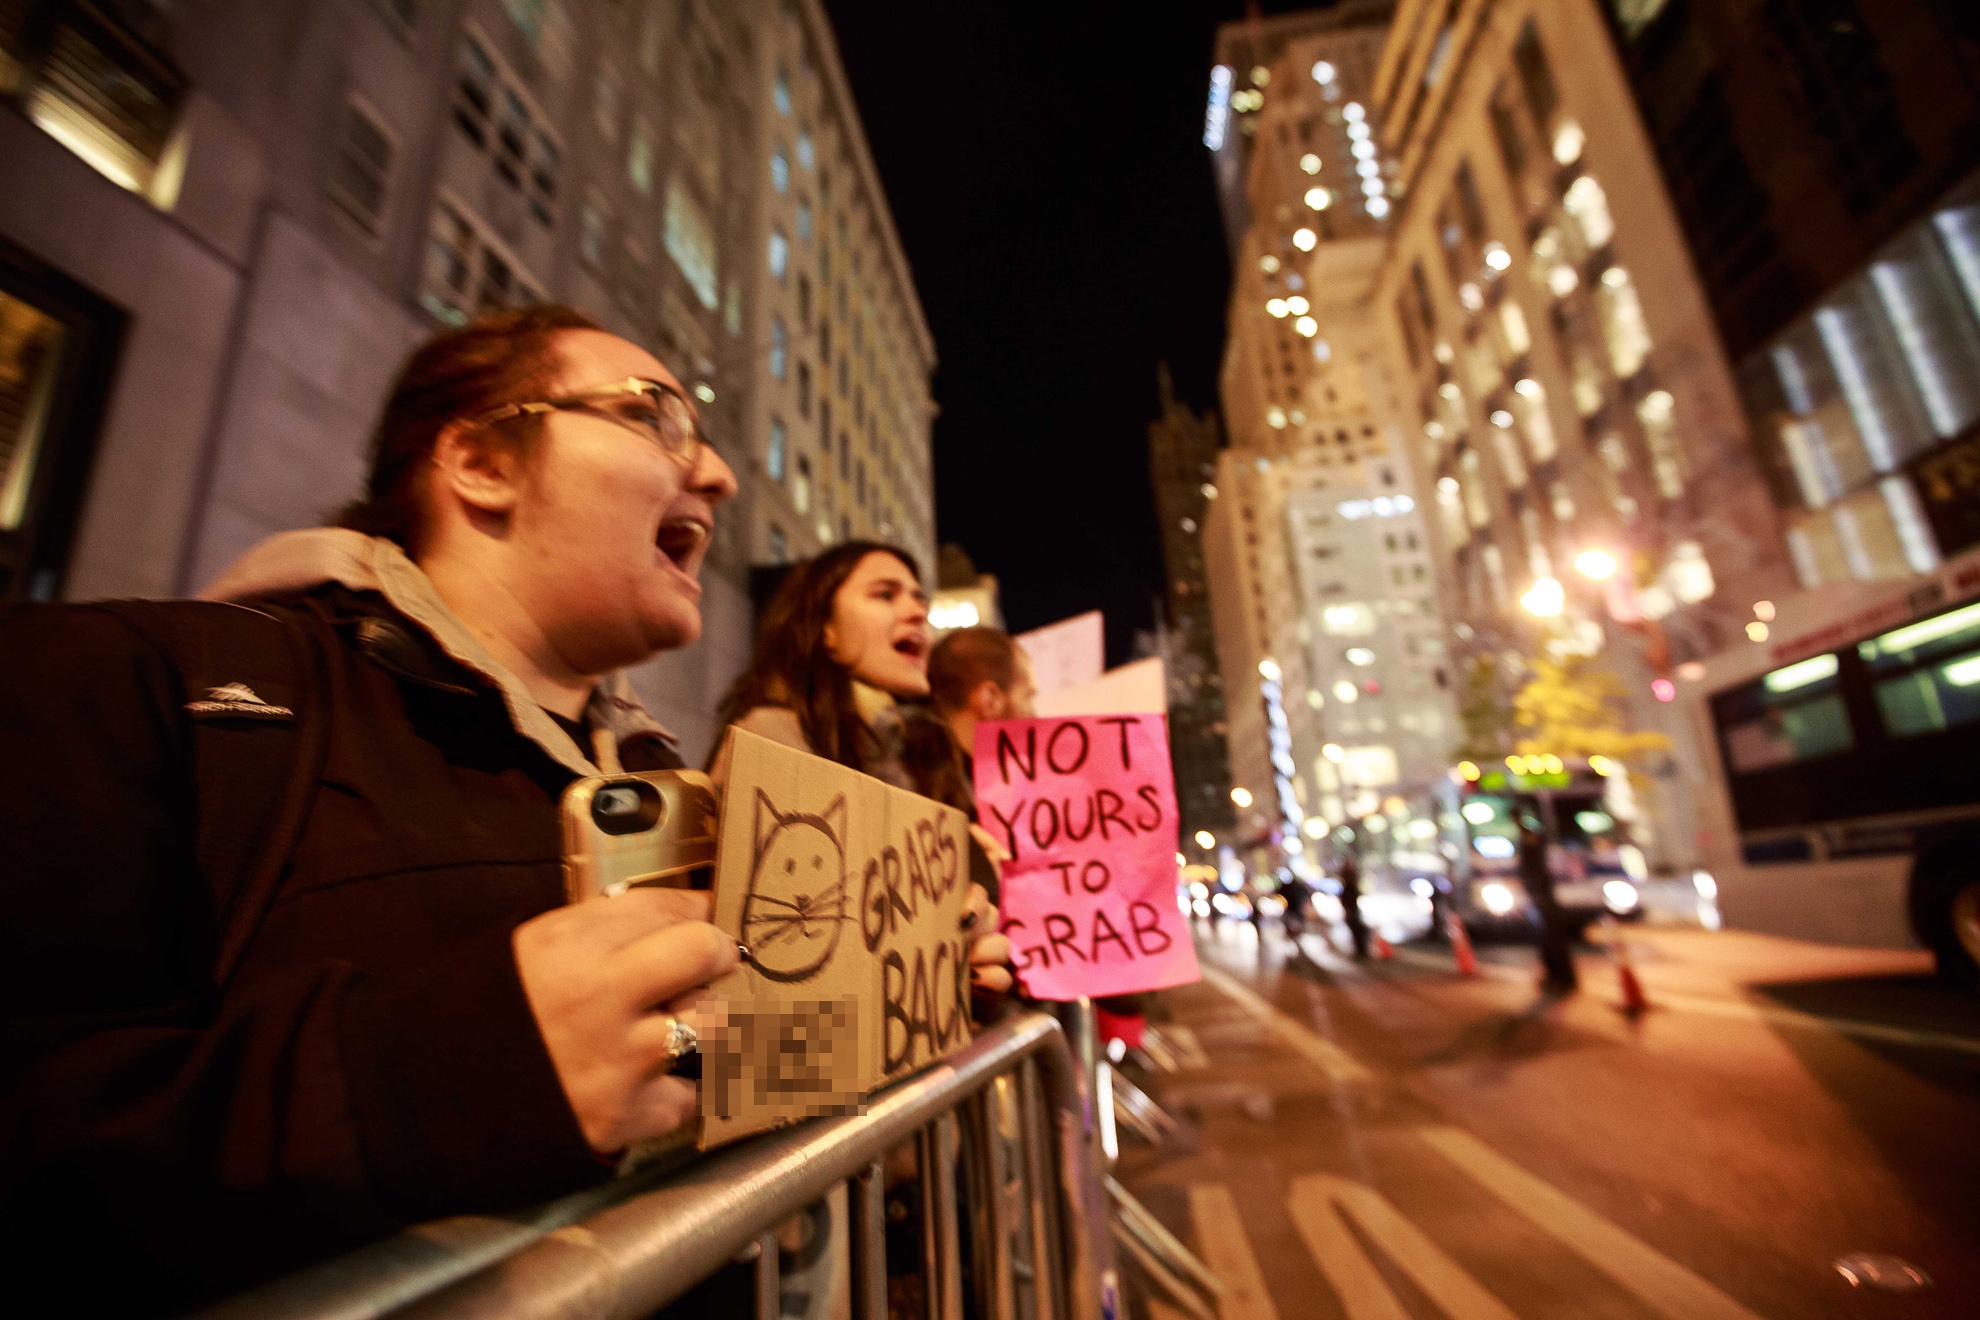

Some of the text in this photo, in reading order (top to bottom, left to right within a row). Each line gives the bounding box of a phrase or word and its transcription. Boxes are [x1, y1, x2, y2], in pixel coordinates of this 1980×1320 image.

[997, 717, 1141, 785] NOT
[990, 785, 1163, 862] YOURS
[861, 808, 959, 953] GRABS
[1050, 860, 1111, 896] TO
[1002, 901, 1173, 969] GRAB
[882, 941, 972, 1076] BACK
